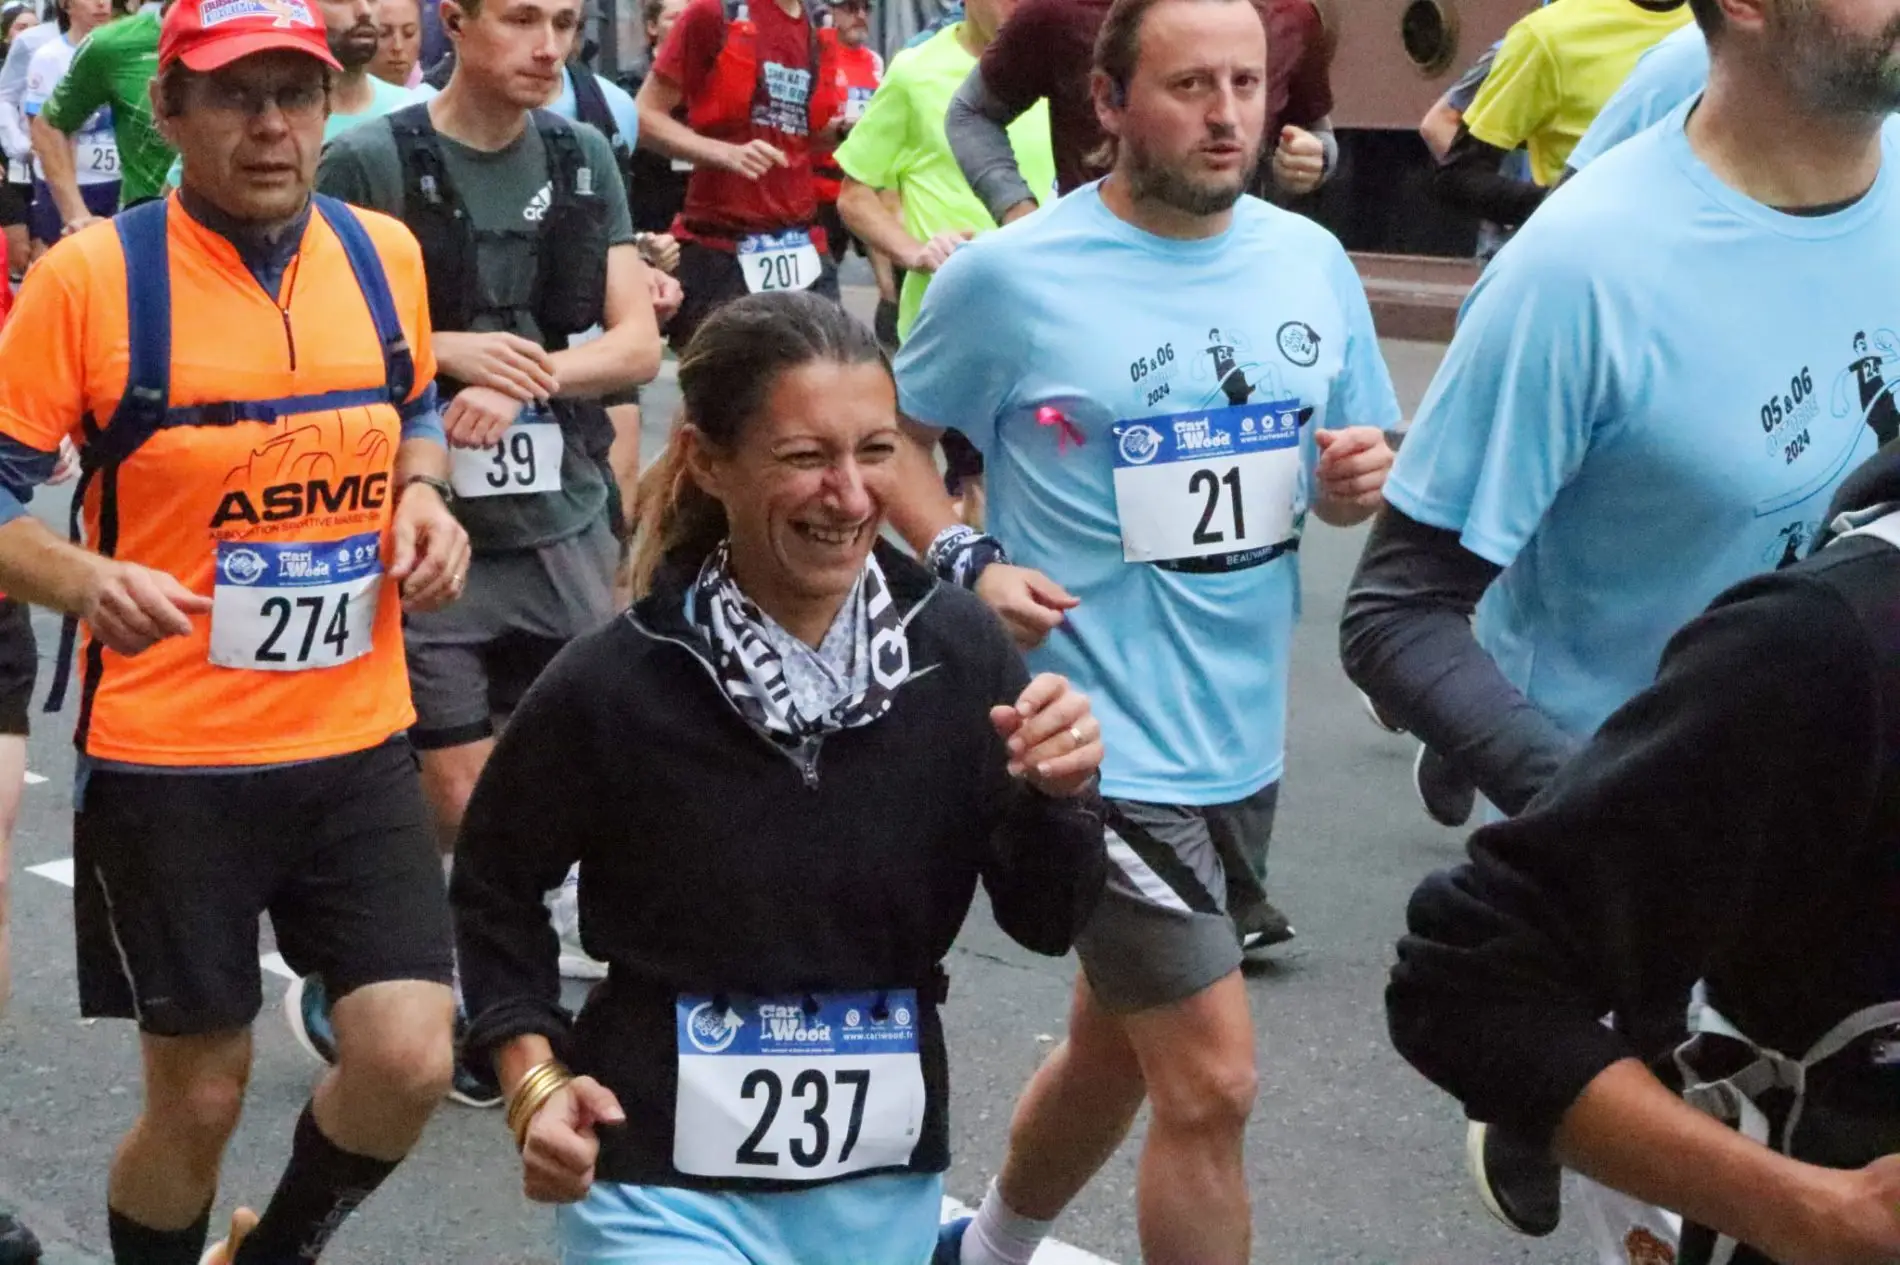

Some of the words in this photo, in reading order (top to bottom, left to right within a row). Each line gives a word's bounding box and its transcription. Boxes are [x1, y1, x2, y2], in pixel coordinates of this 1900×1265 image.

[758, 253, 800, 290] 207
[1130, 356, 1149, 383] 05
[1150, 359, 1158, 372] &
[1157, 342, 1175, 366] 06
[1863, 360, 1880, 381] 24
[1148, 382, 1170, 407] 2024
[1760, 395, 1783, 433] 05
[1783, 395, 1794, 415] &
[1791, 366, 1813, 405] 06
[1183, 430, 1232, 449] Wood
[1784, 427, 1811, 465] 2024
[486, 431, 536, 488] 39
[208, 471, 389, 529] ASMG
[1188, 466, 1246, 545] 21
[255, 592, 350, 662] 274
[769, 1018, 832, 1042] Wood
[842, 1031, 913, 1041] www.cariwood.fr
[735, 1068, 871, 1168] 237
